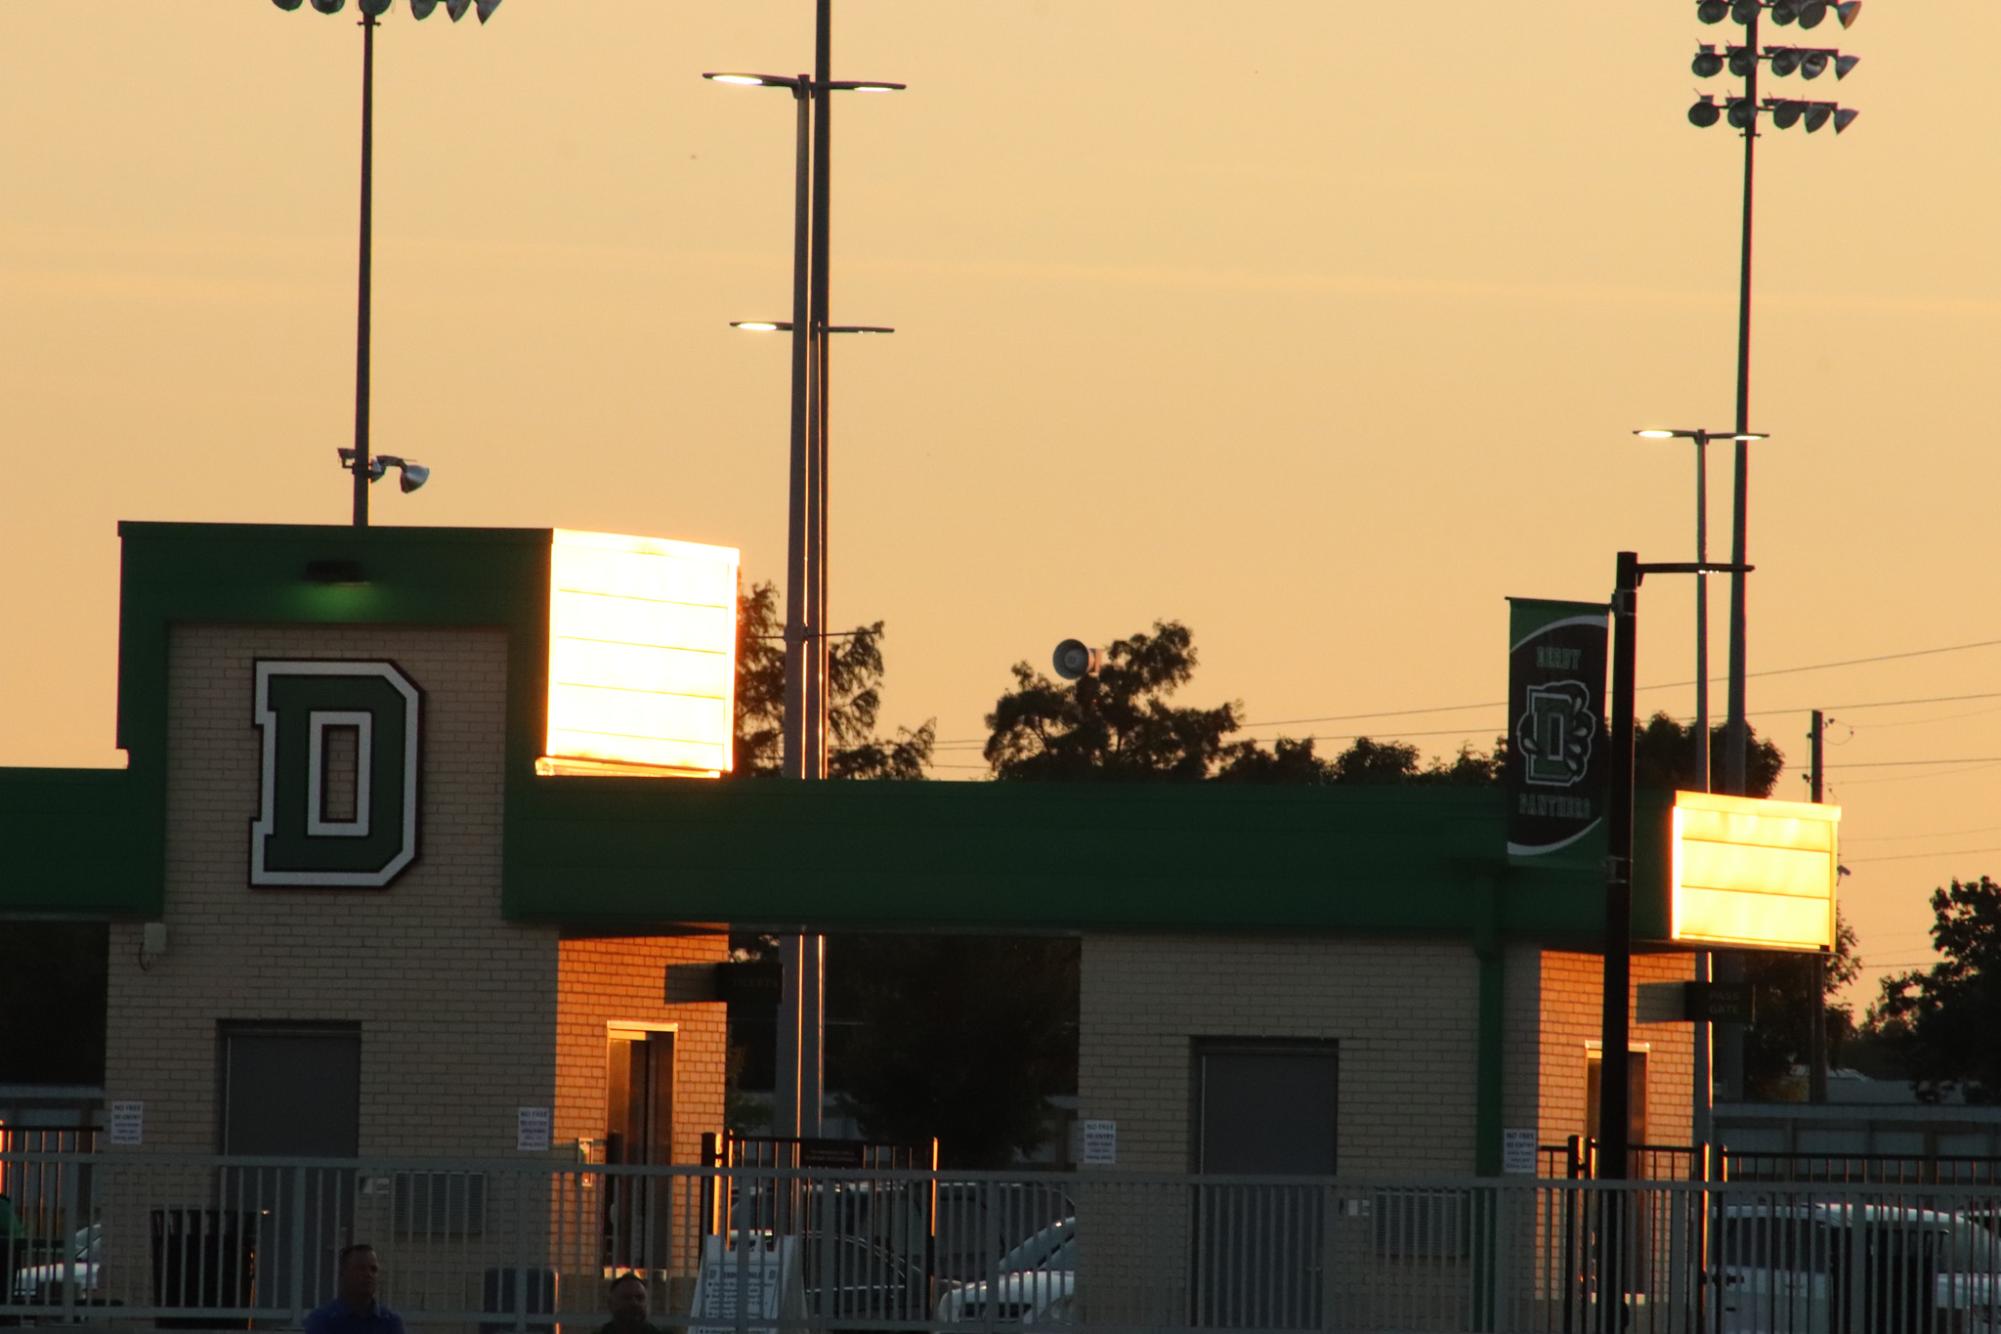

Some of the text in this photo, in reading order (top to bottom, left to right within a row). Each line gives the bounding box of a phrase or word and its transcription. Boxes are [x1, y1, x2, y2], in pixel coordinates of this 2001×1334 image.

[1536, 646, 1582, 670] DERBY
[249, 658, 425, 889] D
[1518, 792, 1591, 819] PANTHERS
